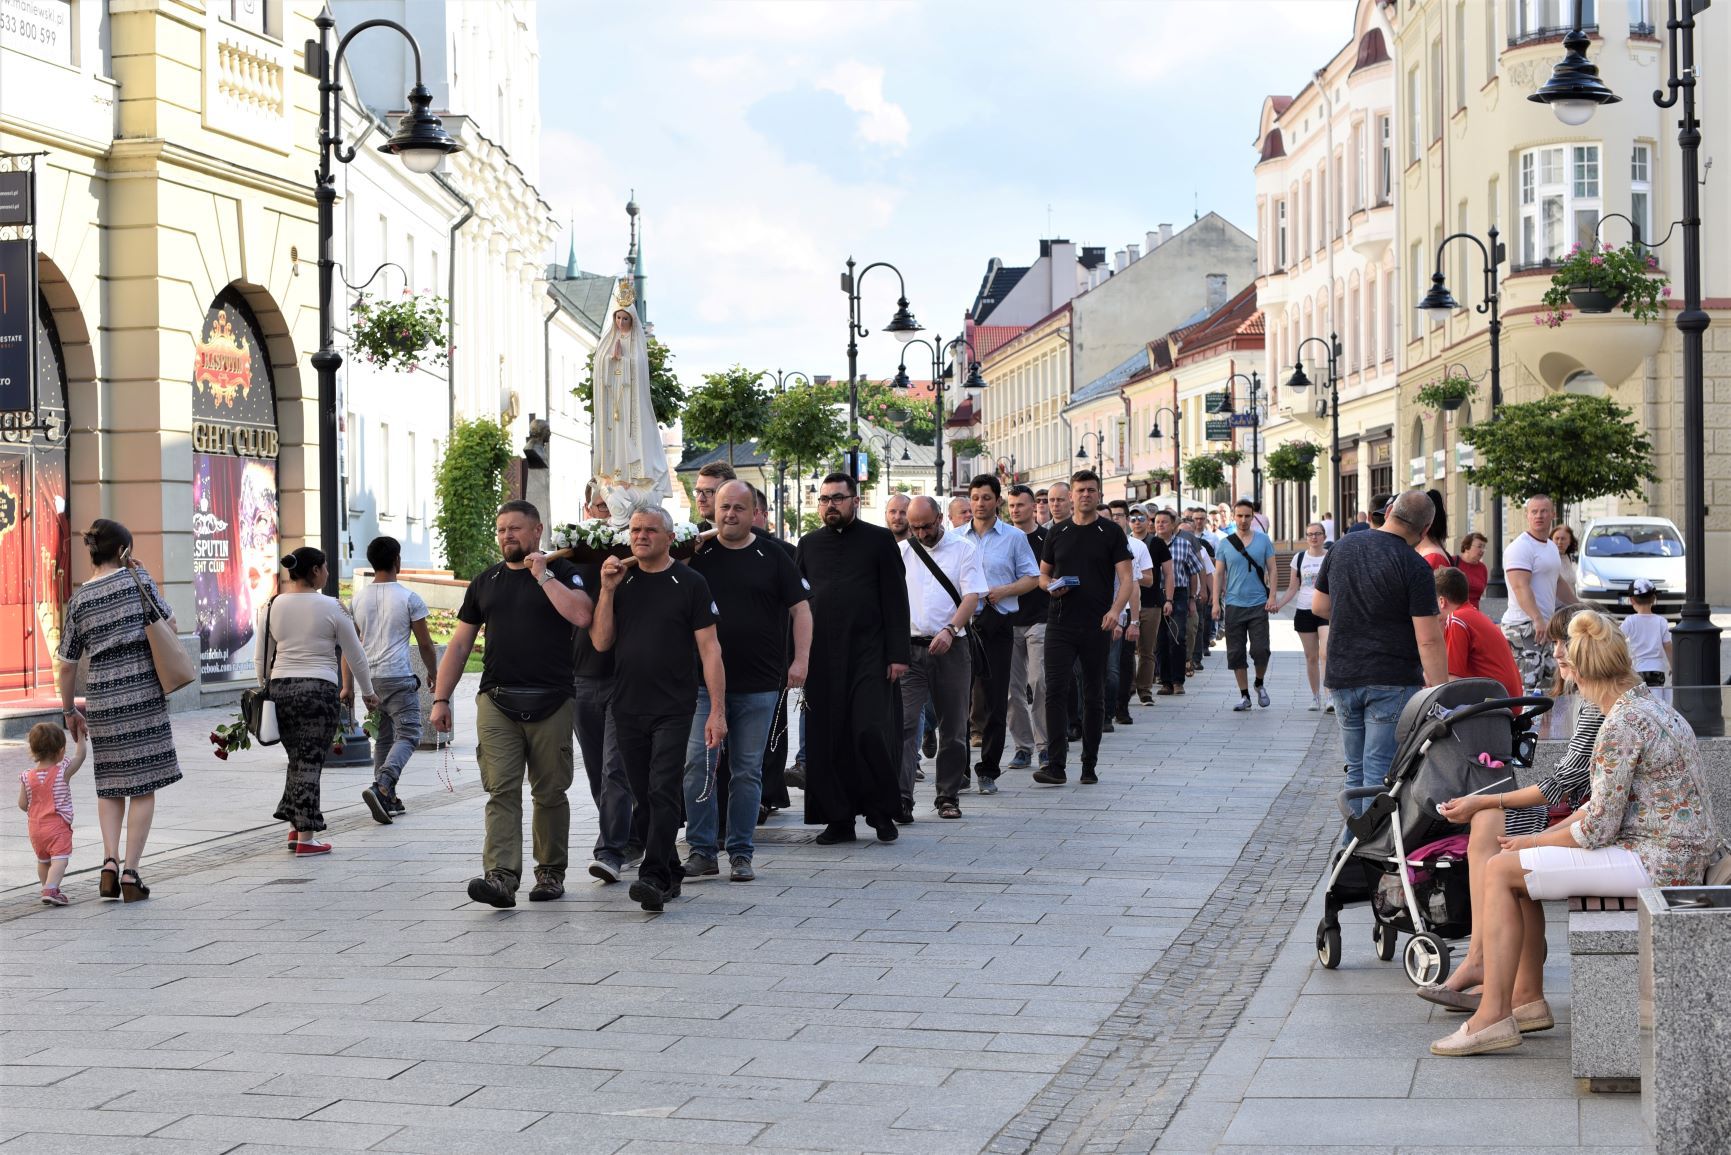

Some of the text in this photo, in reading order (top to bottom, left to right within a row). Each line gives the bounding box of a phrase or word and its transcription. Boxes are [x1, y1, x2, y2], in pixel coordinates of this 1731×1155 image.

[0, 13, 56, 47] 533 800 599
[0, 334, 23, 343] ESTATE
[192, 421, 279, 458] GHT CLUB
[208, 561, 225, 573] CLUB
